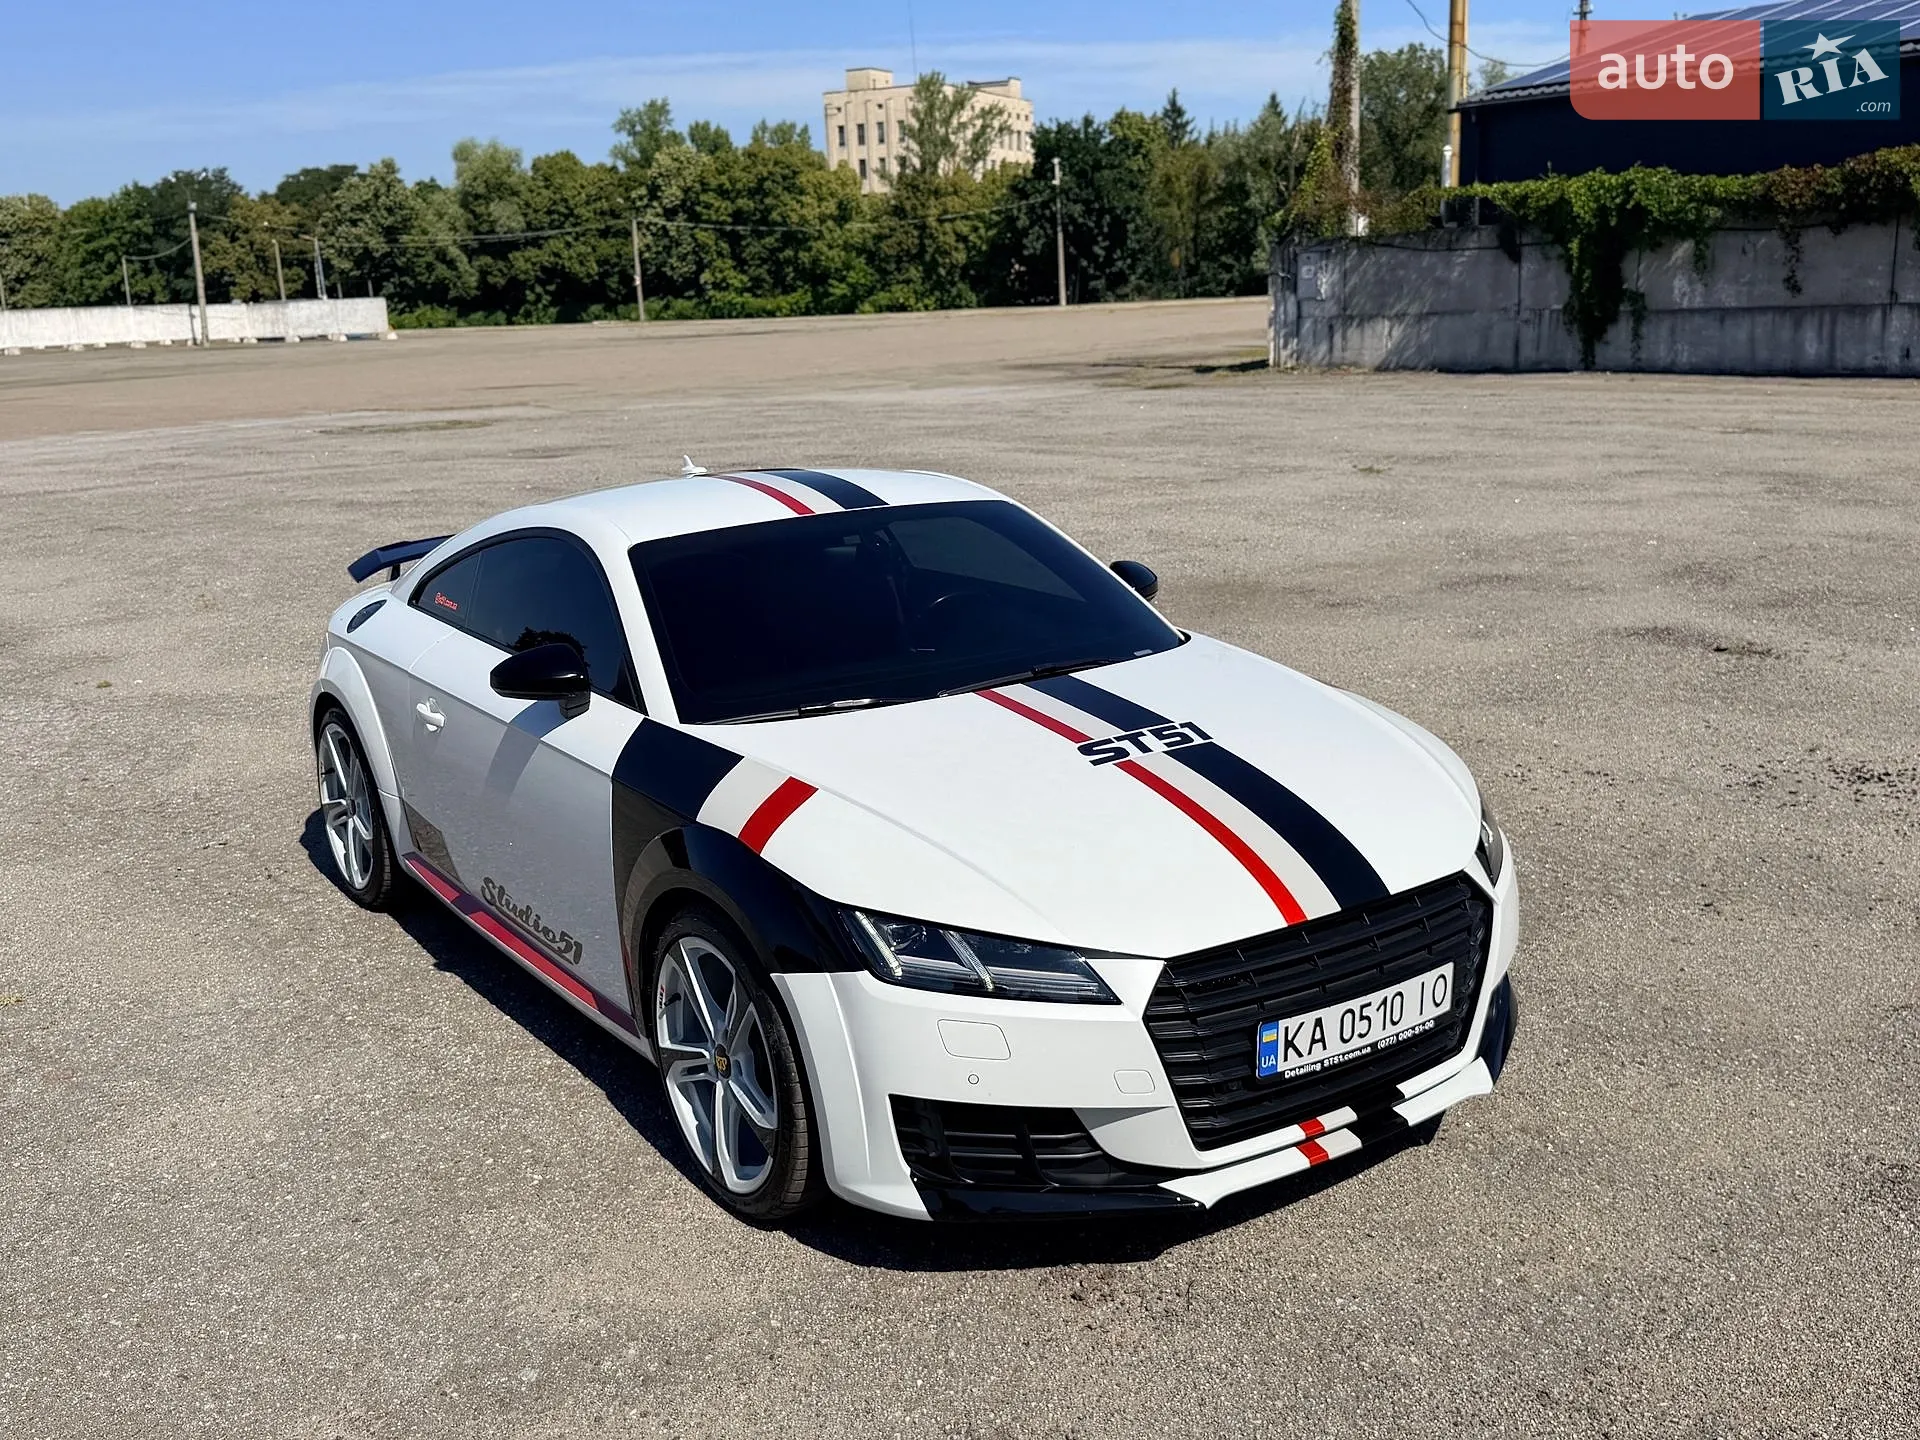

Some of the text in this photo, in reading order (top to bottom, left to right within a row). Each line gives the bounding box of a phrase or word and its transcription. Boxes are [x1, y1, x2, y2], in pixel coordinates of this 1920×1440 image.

[1077, 721, 1214, 766] ST51
[1283, 1017, 1328, 1063] KA
[1339, 991, 1403, 1044] 0510
[1261, 1056, 1276, 1069] UA
[1284, 1062, 1322, 1079] Detailing
